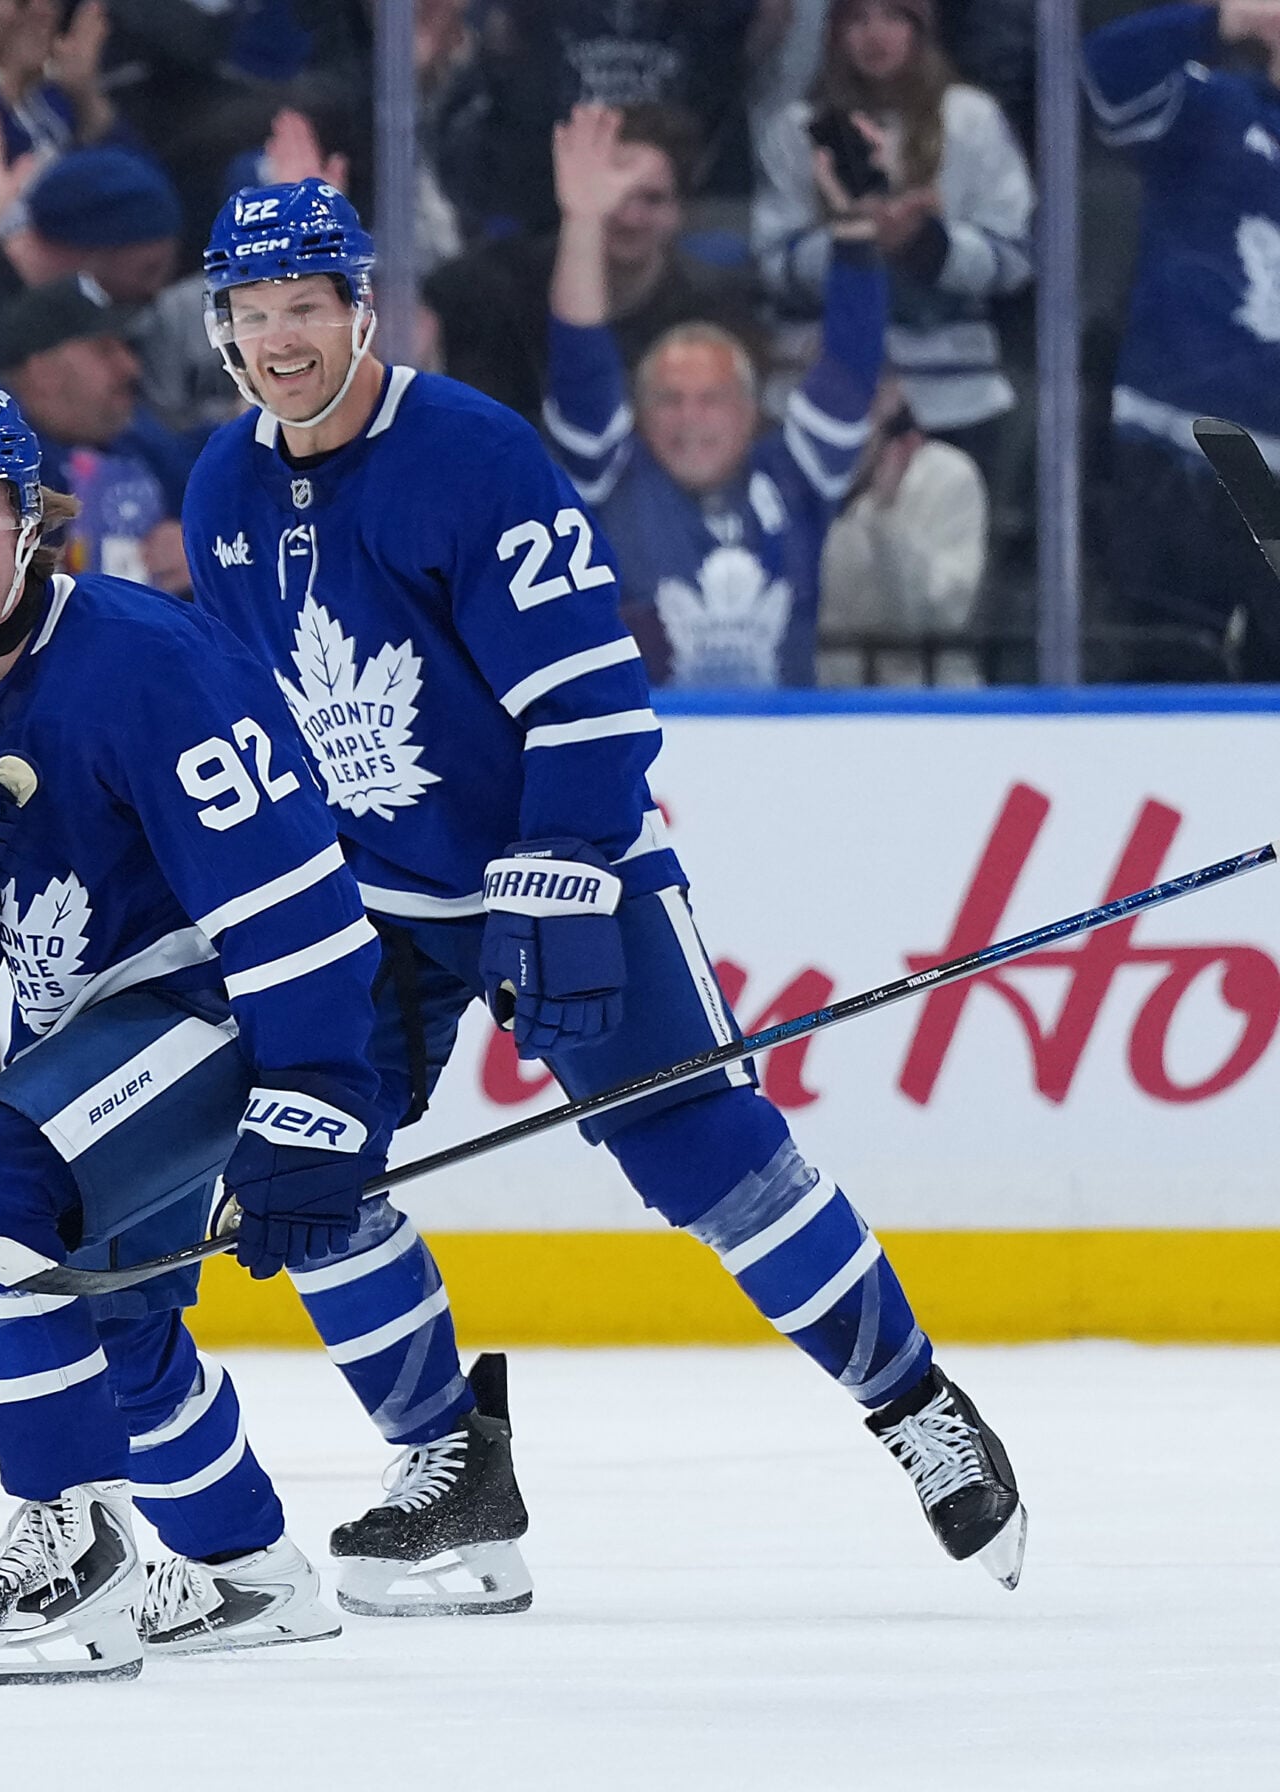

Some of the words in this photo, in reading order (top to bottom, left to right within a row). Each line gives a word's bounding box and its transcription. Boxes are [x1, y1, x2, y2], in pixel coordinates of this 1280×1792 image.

[241, 198, 280, 226] 22
[235, 237, 291, 257] CCM
[496, 507, 616, 612] 22
[303, 701, 395, 743] TORONTO
[320, 729, 386, 760] MAPLE
[175, 716, 301, 832] 92
[331, 753, 396, 784] LEAFS
[484, 870, 601, 904] ARRIOR
[0, 921, 64, 959] ONTO
[10, 956, 55, 978] PLE
[17, 979, 65, 1001] AFS
[88, 1070, 153, 1126] BAUER
[244, 1098, 347, 1146] UER
